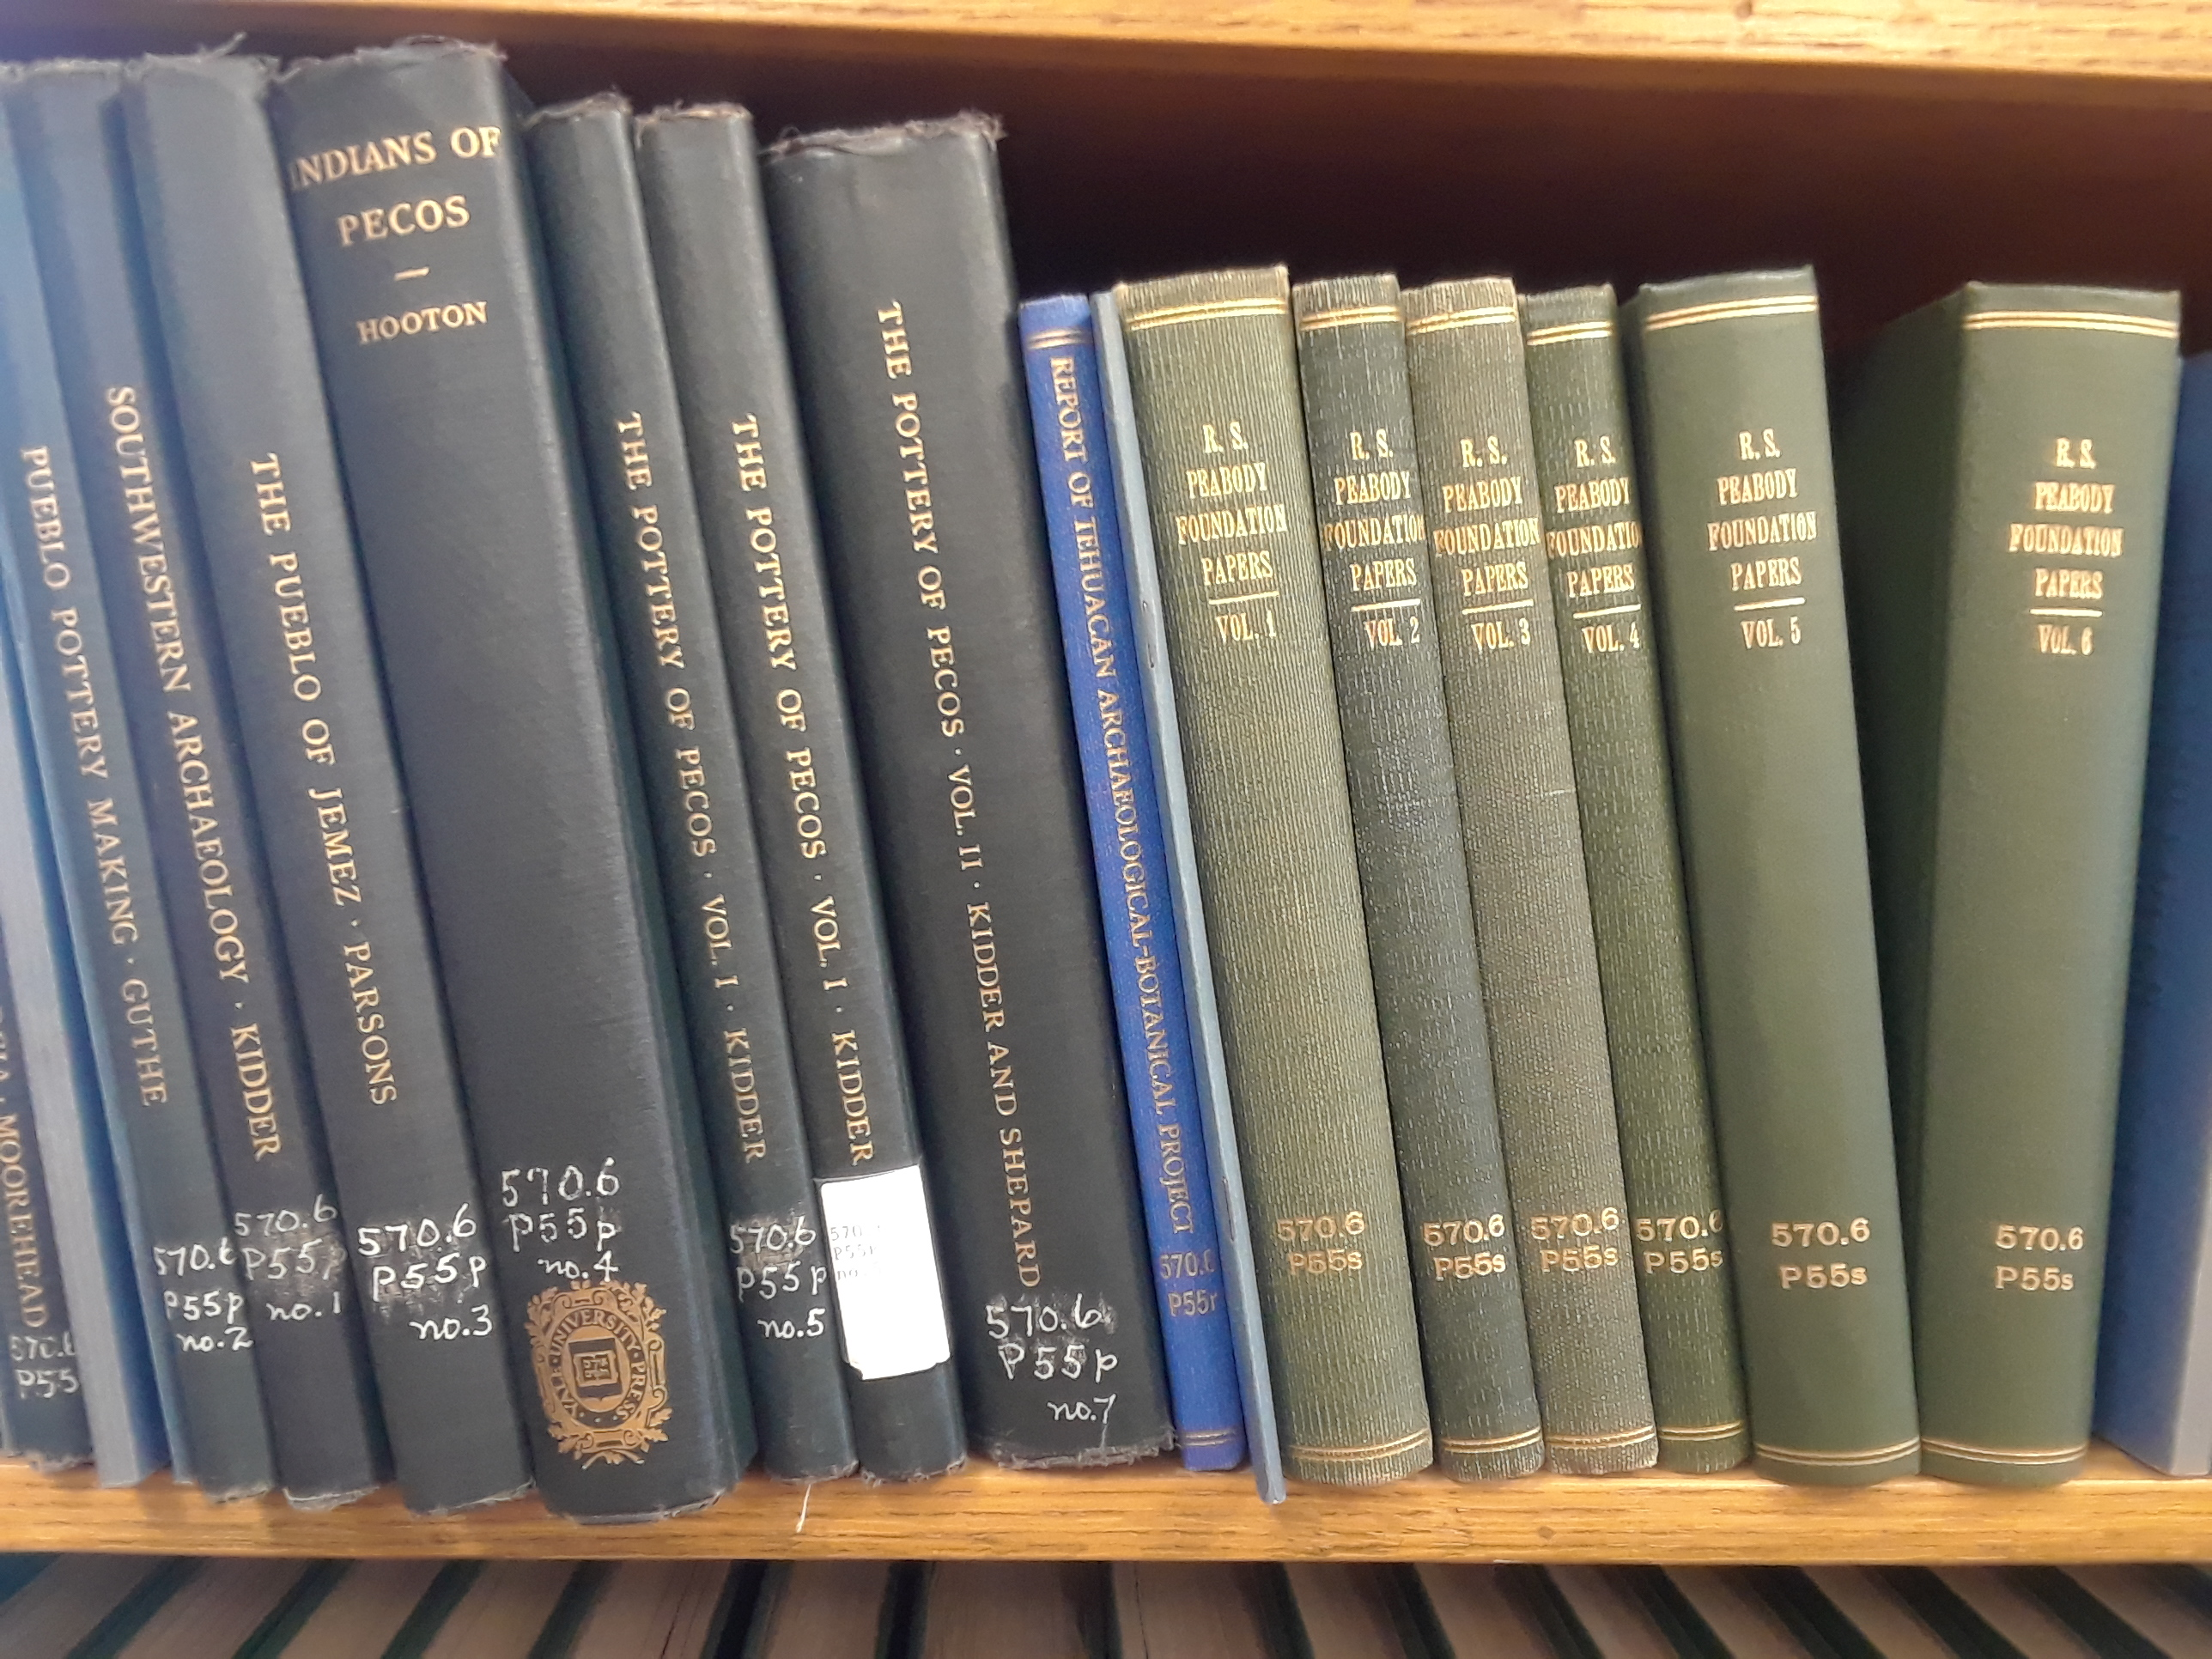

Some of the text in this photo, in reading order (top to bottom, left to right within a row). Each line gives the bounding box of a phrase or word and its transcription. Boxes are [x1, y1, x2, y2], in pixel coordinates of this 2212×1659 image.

[450, 125, 501, 159] OF
[337, 194, 471, 247] PECOS
[356, 301, 488, 345] HOOTON
[1049, 356, 1089, 465] REPORT
[1202, 422, 1249, 453] R. S.
[1350, 428, 1394, 460] R. S.
[1460, 434, 1508, 468] R. S.
[1574, 435, 1616, 468] R. S.
[1739, 428, 1781, 460] R. S.
[2056, 437, 2096, 470] R. S.
[1067, 470, 1095, 509] OF
[1186, 462, 1267, 499] PEABODY
[1334, 471, 1411, 506] PEABODY
[1442, 476, 1523, 514] PEABODY
[1554, 477, 1630, 514] PEABODY
[1717, 467, 1798, 506] PEABODY
[2034, 481, 2115, 514] PEABODY
[1176, 503, 1288, 545] FOUNDATION
[1322, 514, 1426, 551] FOUNDATION
[1432, 517, 1541, 556] FOUNDATION
[1546, 520, 1643, 558] FOUNDATIO
[1707, 511, 1818, 551] FOUNDATION
[2008, 523, 2124, 558] FOUNDATION
[1201, 550, 1273, 586] PAPERS
[1350, 557, 1417, 592] PAPERS
[1462, 561, 1528, 597] PAPERS
[1566, 562, 1635, 599] PAPERS
[1730, 556, 1802, 591] PAPERS
[2034, 567, 2103, 599] PAPERS
[1074, 516, 1117, 679] TEHUACAN
[1215, 610, 1277, 643] VOL. 1
[1364, 616, 1420, 648] VOL. 2
[1471, 617, 1531, 654] VOL. 3
[1582, 621, 1640, 654] VOL. 4
[1740, 617, 1801, 650] VOL. 5
[2037, 623, 2094, 656] VOL. 6
[21, 446, 168, 1108] PUEBLO POTTERY MAKING GUTHE
[106, 386, 283, 1162] SOUTHWESTERN ARCHAEOLOGY KIDDER
[250, 452, 398, 1106] THE PUEBLO OF JEMEZ PARSONS
[617, 410, 767, 1164] THE POTTERY OF PECOS VOL. I KIDDER
[731, 412, 874, 1166] THE POTTERY OF PECOS VOL. I KIDDER
[877, 298, 1042, 1287] THE POTTERY OF PECOS VOL. II KIDDER AND SHEPARD
[501, 1157, 621, 1208] 570.6
[1157, 1122, 1194, 1236] PROJECT
[0, 1115, 49, 1328] MOOREHEAD
[233, 1193, 339, 1237] 570.6
[357, 1202, 477, 1256] 570.6
[508, 1206, 617, 1253] P55p
[1277, 1211, 1365, 1242] 570.6
[1423, 1213, 1505, 1247] 570.6
[1531, 1206, 1620, 1240] 570.6
[1771, 1217, 1870, 1248] 570.6
[730, 1214, 816, 1254] 570.6
[1995, 1224, 2084, 1252] 570.6
[1288, 1249, 1363, 1275] P55s
[1434, 1251, 1505, 1282] P55s
[1539, 1245, 1620, 1273] P55s
[1643, 1247, 1723, 1273] P55s
[1779, 1262, 1869, 1290] P55s
[372, 1251, 488, 1304] P55p
[1995, 1265, 2074, 1291] P55s
[163, 1291, 244, 1325] P55p
[985, 1292, 1103, 1340] 570.6
[551, 1309, 641, 1356] UNIVERSITY
[616, 1361, 647, 1419] PRESS
